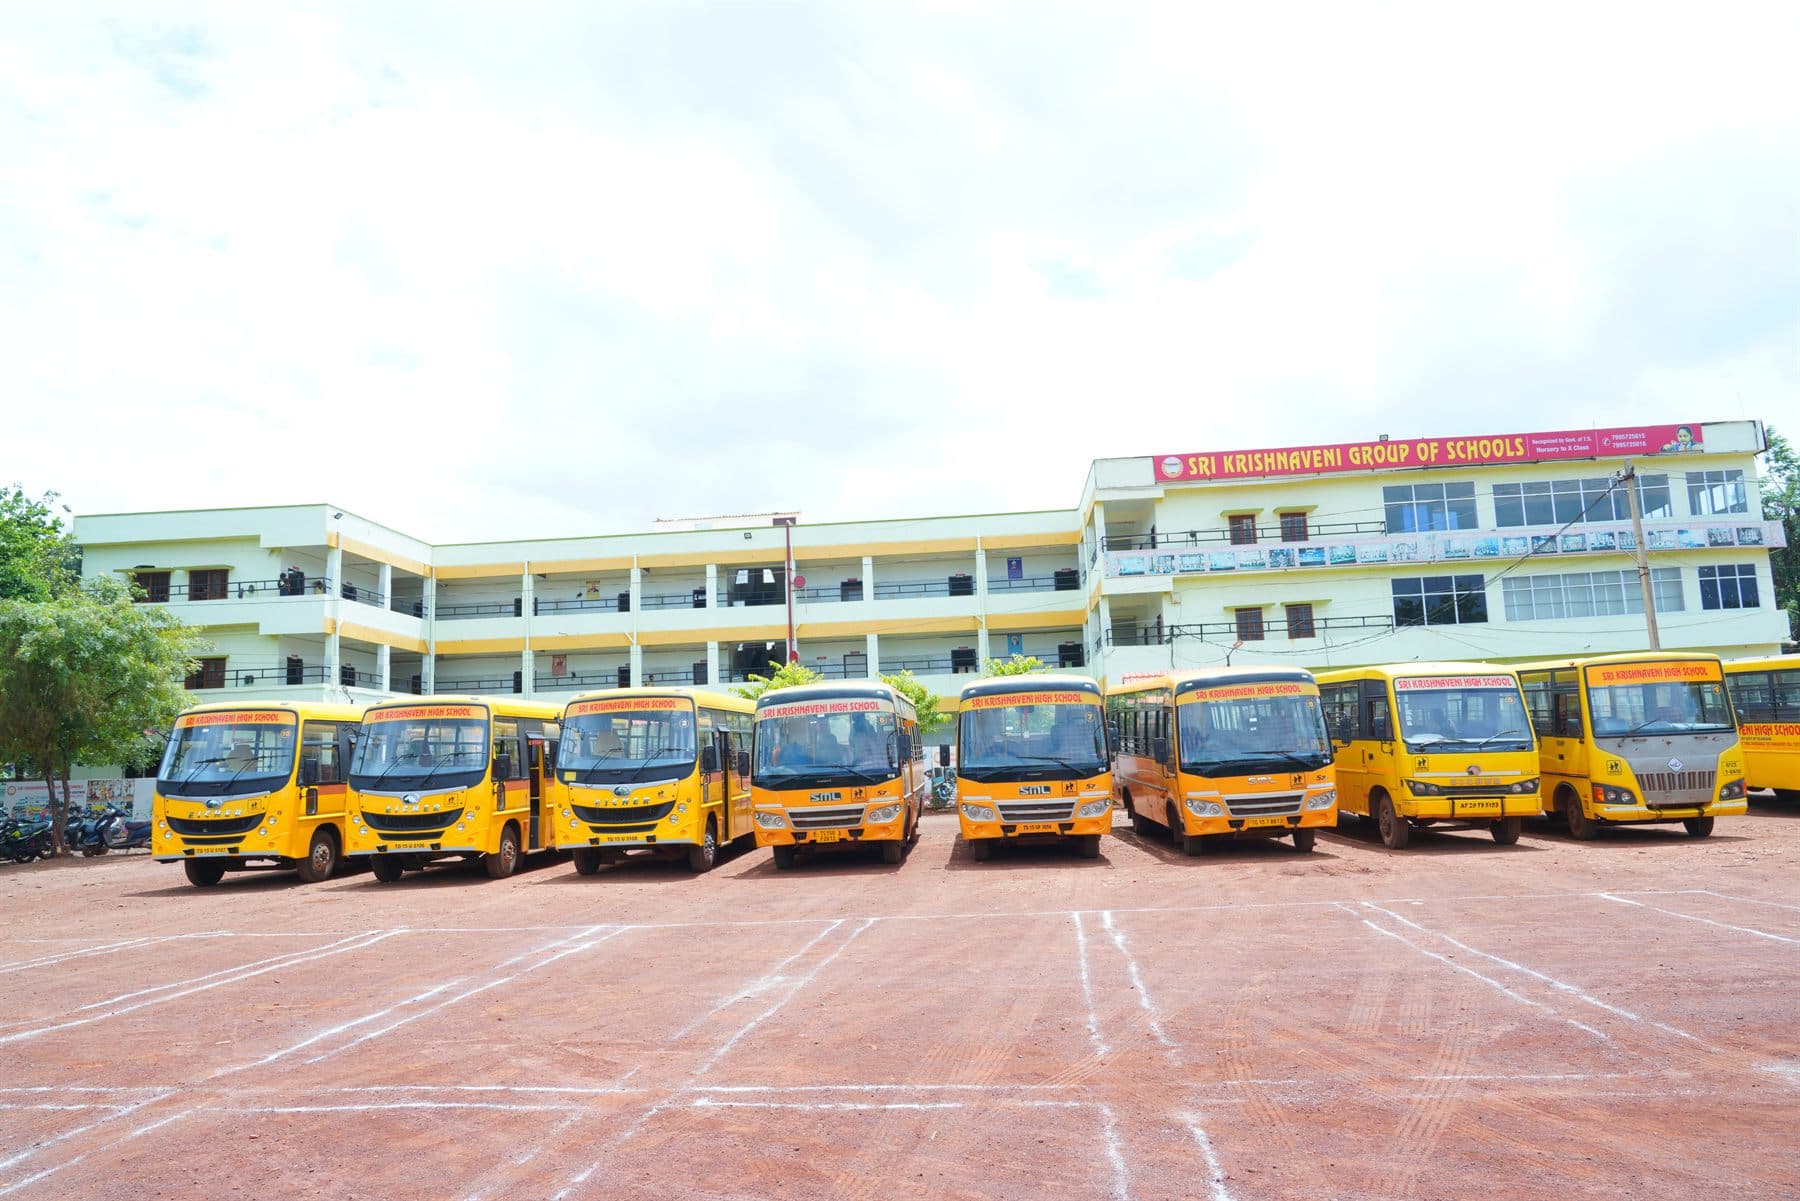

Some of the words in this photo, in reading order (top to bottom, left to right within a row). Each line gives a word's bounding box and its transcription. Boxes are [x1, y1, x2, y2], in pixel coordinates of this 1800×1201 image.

[1188, 456, 1216, 476] SRI
[1223, 447, 1343, 474] KRISHNAVENI
[1349, 441, 1410, 465] GROUP
[1417, 441, 1439, 462] OF
[1447, 437, 1525, 459] SCHOOLS
[1602, 672, 1614, 681] SRI
[1616, 668, 1663, 680] KRISHNAVENI
[1664, 668, 1681, 678] HIGH
[1683, 666, 1708, 676] SCHOOL
[1398, 680, 1411, 689] SRI
[1412, 678, 1462, 688] KRISHNAVENI
[1464, 678, 1482, 687] HIGH
[1483, 678, 1512, 687] SCHOOL
[1196, 691, 1207, 700] SRI
[1209, 687, 1255, 699] KRISHNAVENI
[1257, 686, 1274, 696] HIGH
[1276, 684, 1302, 694] SCHOOL
[578, 704, 588, 713] SRI
[590, 701, 632, 712] KRISHNAVENI
[634, 700, 650, 709] HIGH
[652, 700, 676, 708] SCHOOL
[971, 699, 983, 708] SRI
[984, 694, 1033, 707] KRISHNAVENI
[1035, 694, 1053, 703] HIGH
[1054, 693, 1082, 702] SCHOOL
[375, 712, 384, 720] SRI
[427, 708, 444, 716] HIGH
[446, 708, 471, 716] SCHOOL
[763, 708, 775, 718] SRI
[776, 704, 827, 716] KRISHNAVENI
[830, 703, 848, 712] HIGH
[850, 701, 880, 711] SCHOOL
[185, 717, 194, 726] SRI
[237, 714, 252, 722] HIGH
[254, 713, 278, 721] SCHOOL
[1755, 724, 1772, 736] HIGH
[595, 797, 650, 806] EICHER
